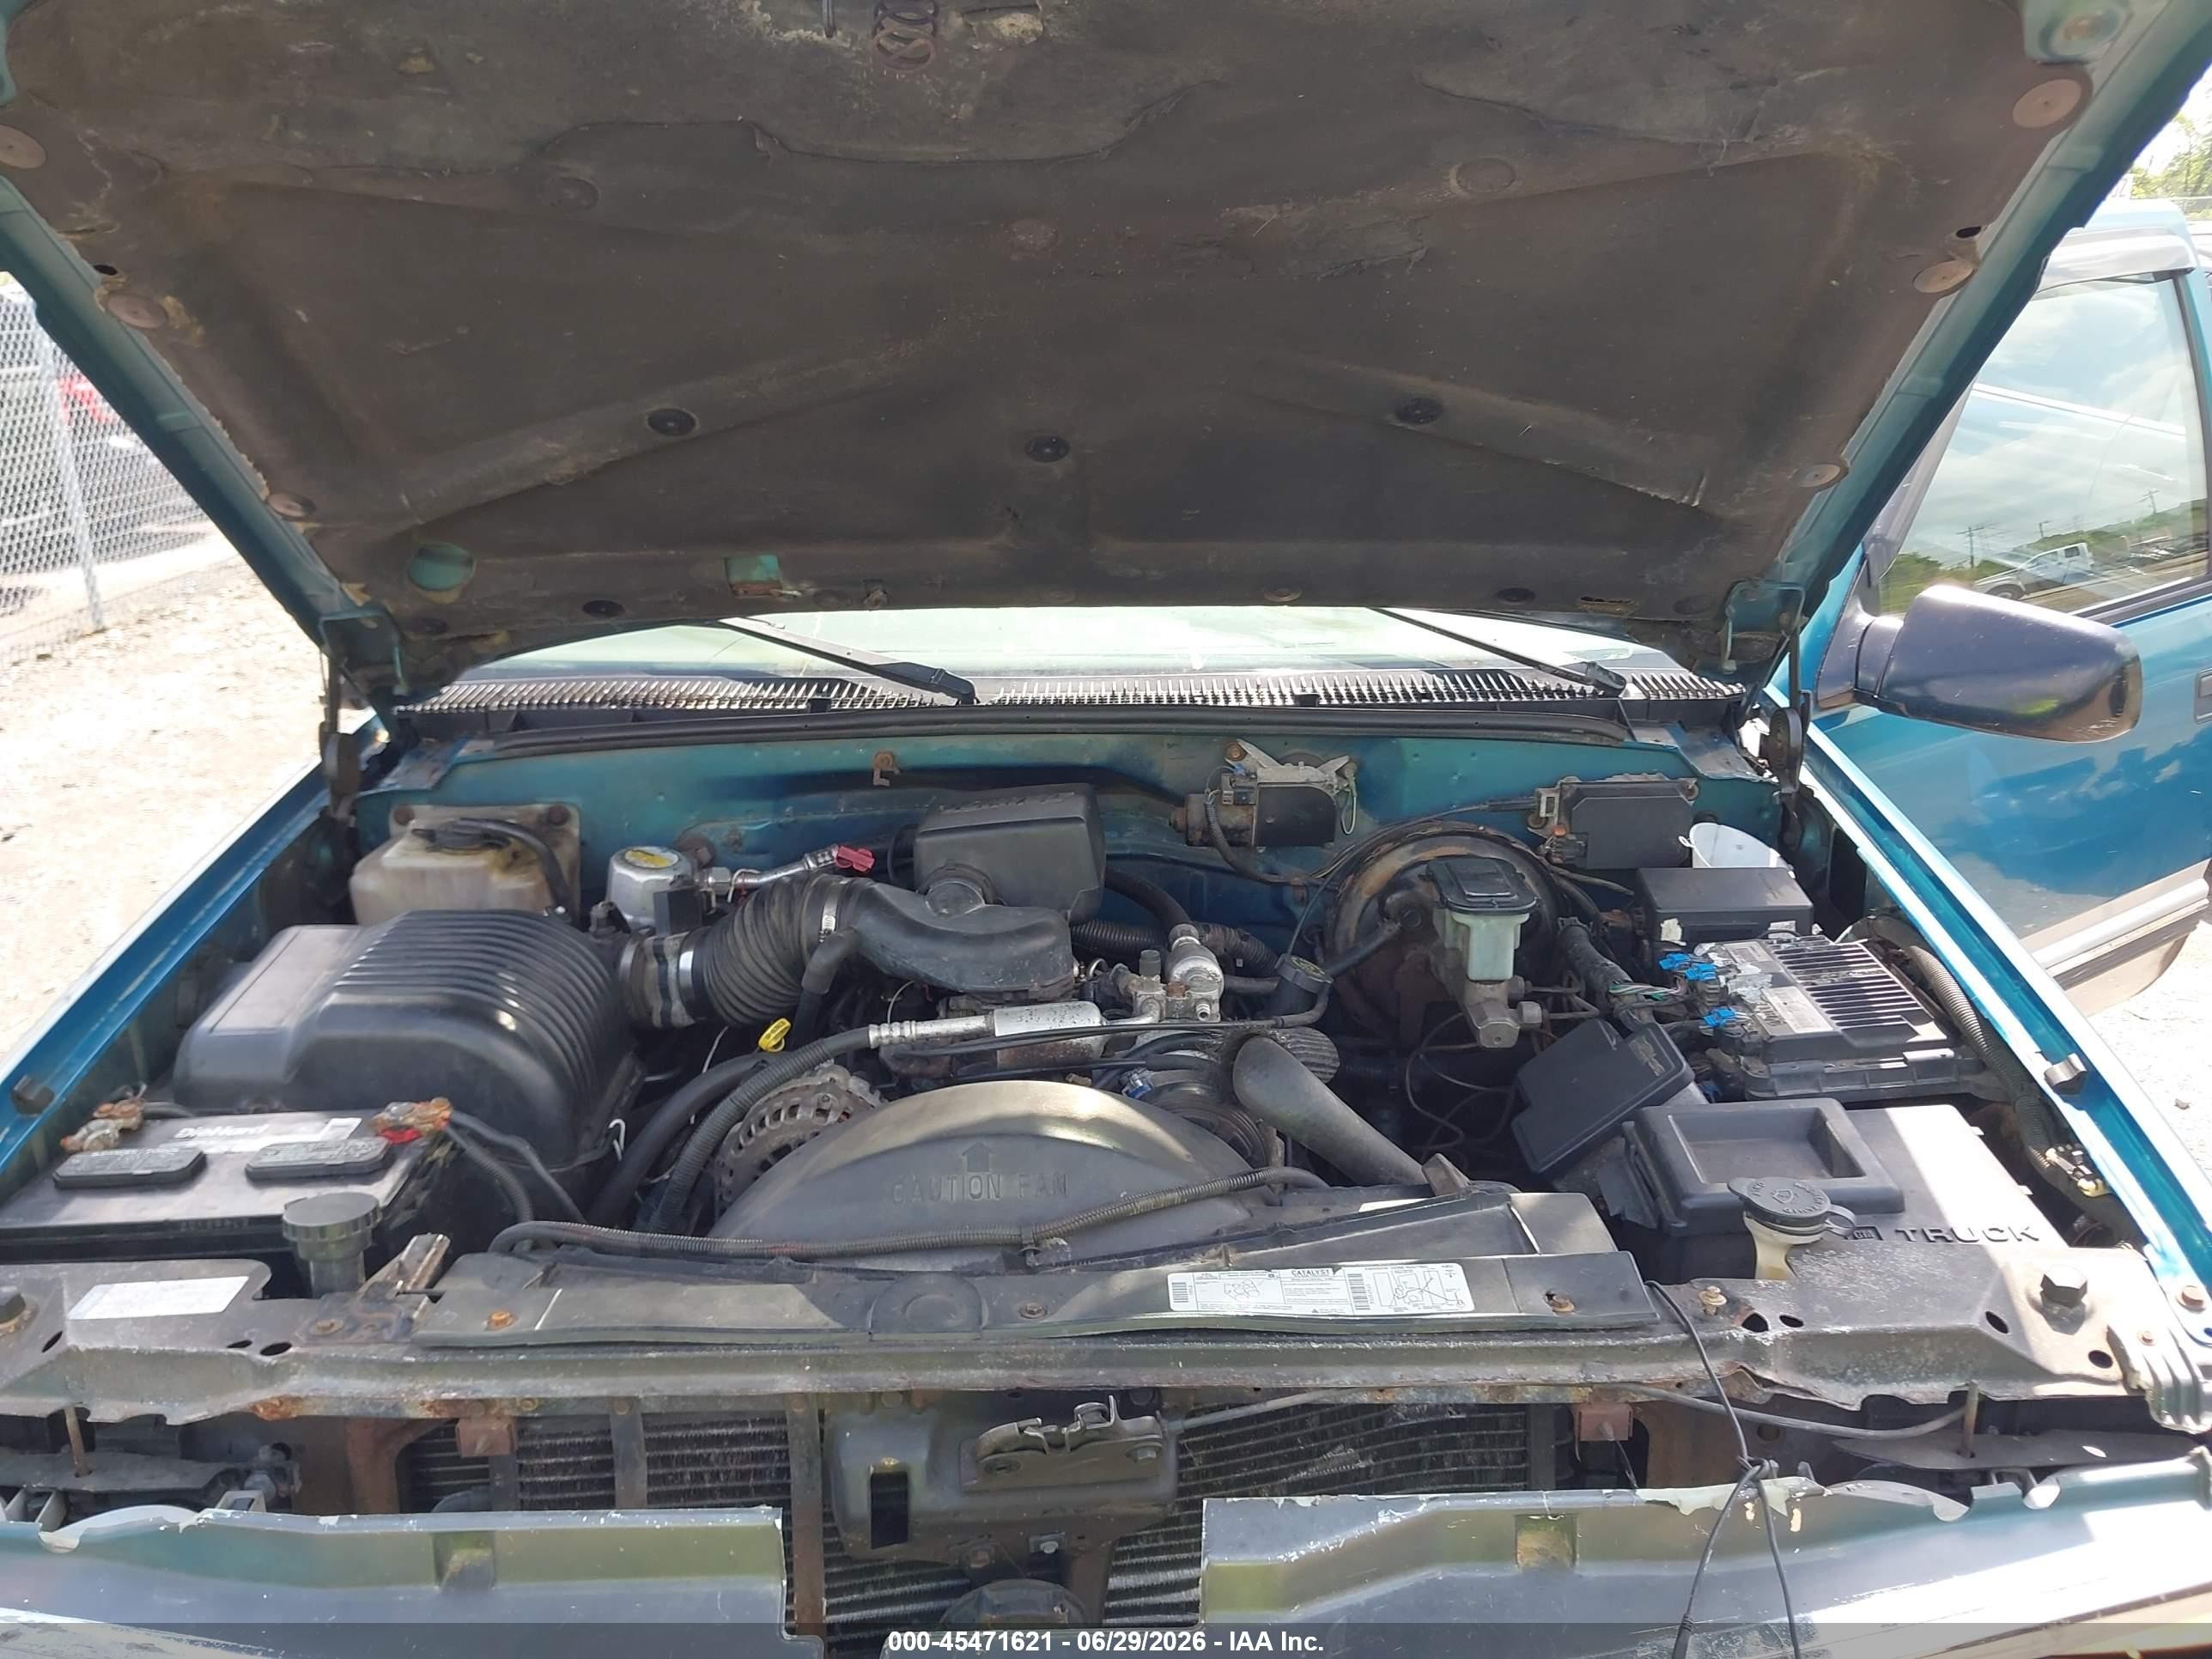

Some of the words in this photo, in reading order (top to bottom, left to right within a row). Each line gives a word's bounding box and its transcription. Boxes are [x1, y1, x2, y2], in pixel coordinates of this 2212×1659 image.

[891, 1173, 1003, 1204] CAUTION
[1017, 1170, 1072, 1199] FAN
[1893, 1226, 2040, 1243] TRUCK
[1291, 1269, 1331, 1278] CATALYST
